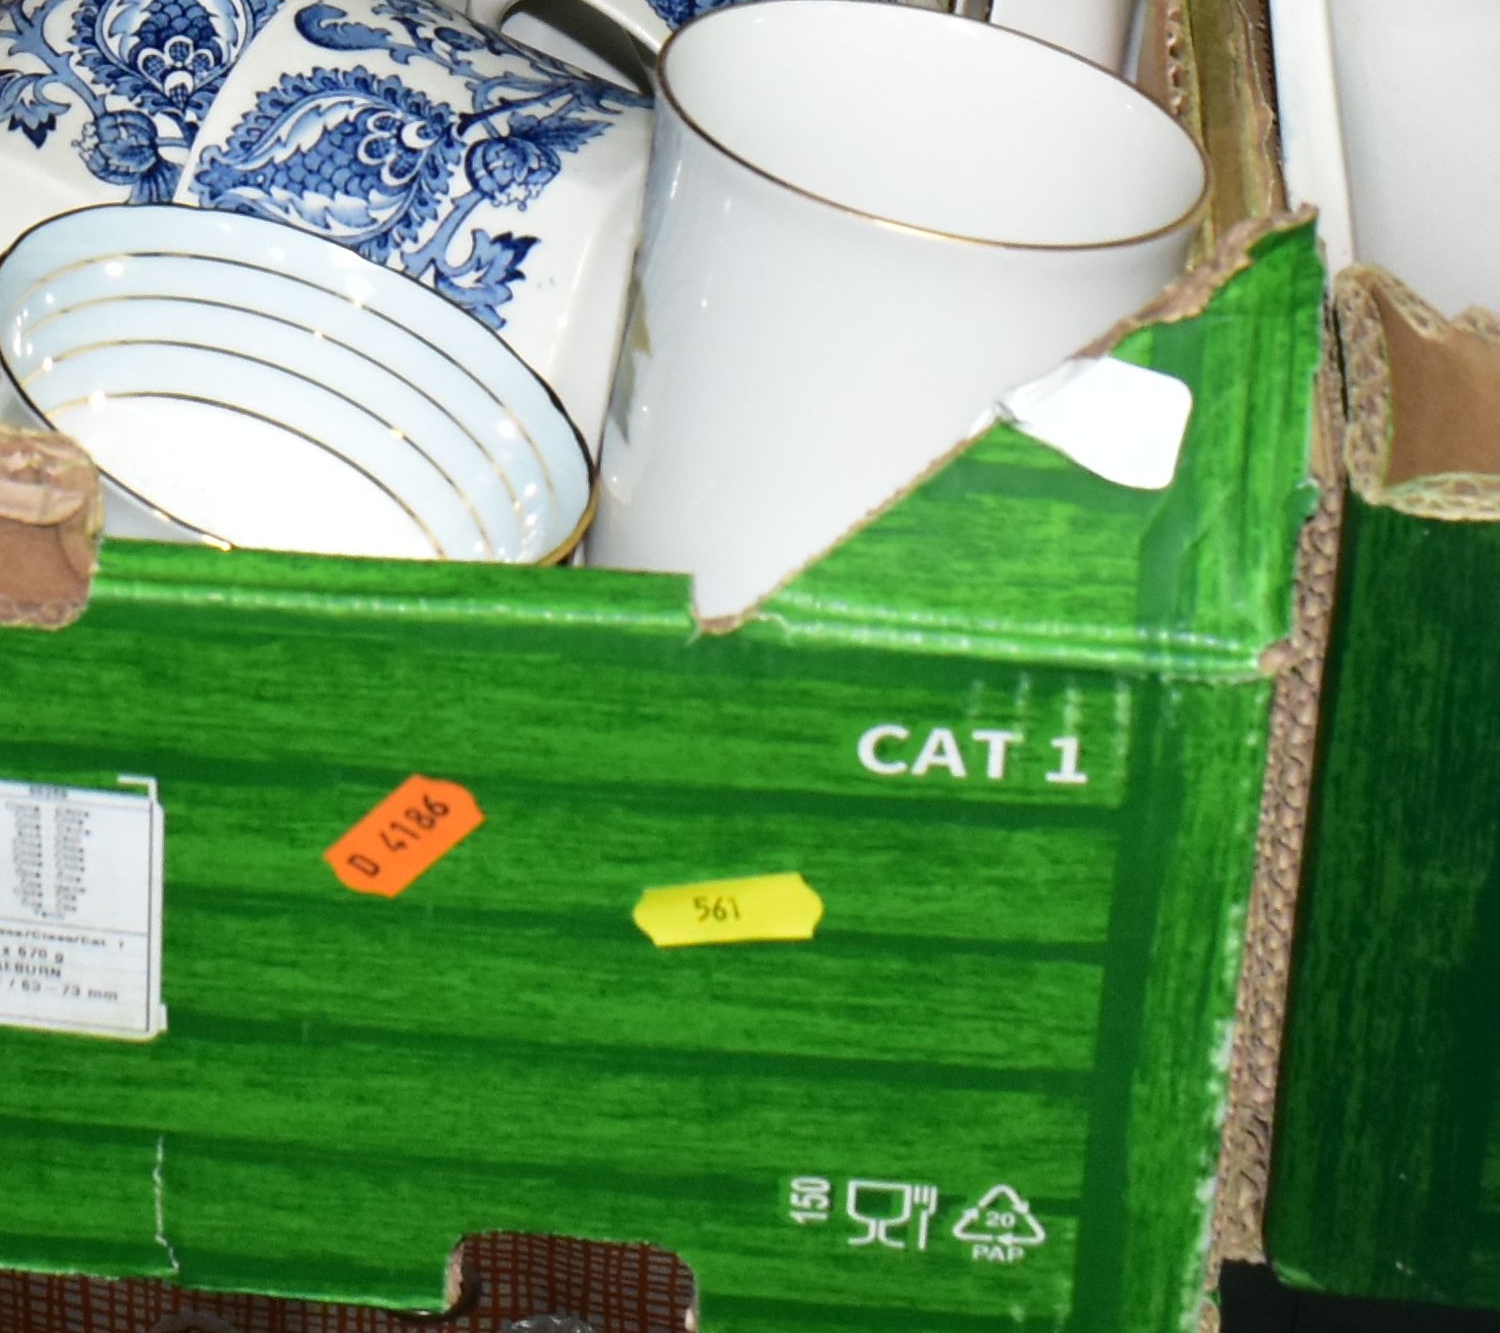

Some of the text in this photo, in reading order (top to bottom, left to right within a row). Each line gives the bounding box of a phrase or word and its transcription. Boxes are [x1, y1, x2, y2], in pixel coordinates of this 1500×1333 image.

[856, 723, 1089, 785] CAT 1
[346, 792, 452, 879] D 4186
[690, 894, 743, 923] 561
[788, 1175, 832, 1224] 150
[985, 1210, 1016, 1228] 20
[972, 1243, 1026, 1263] PAP
